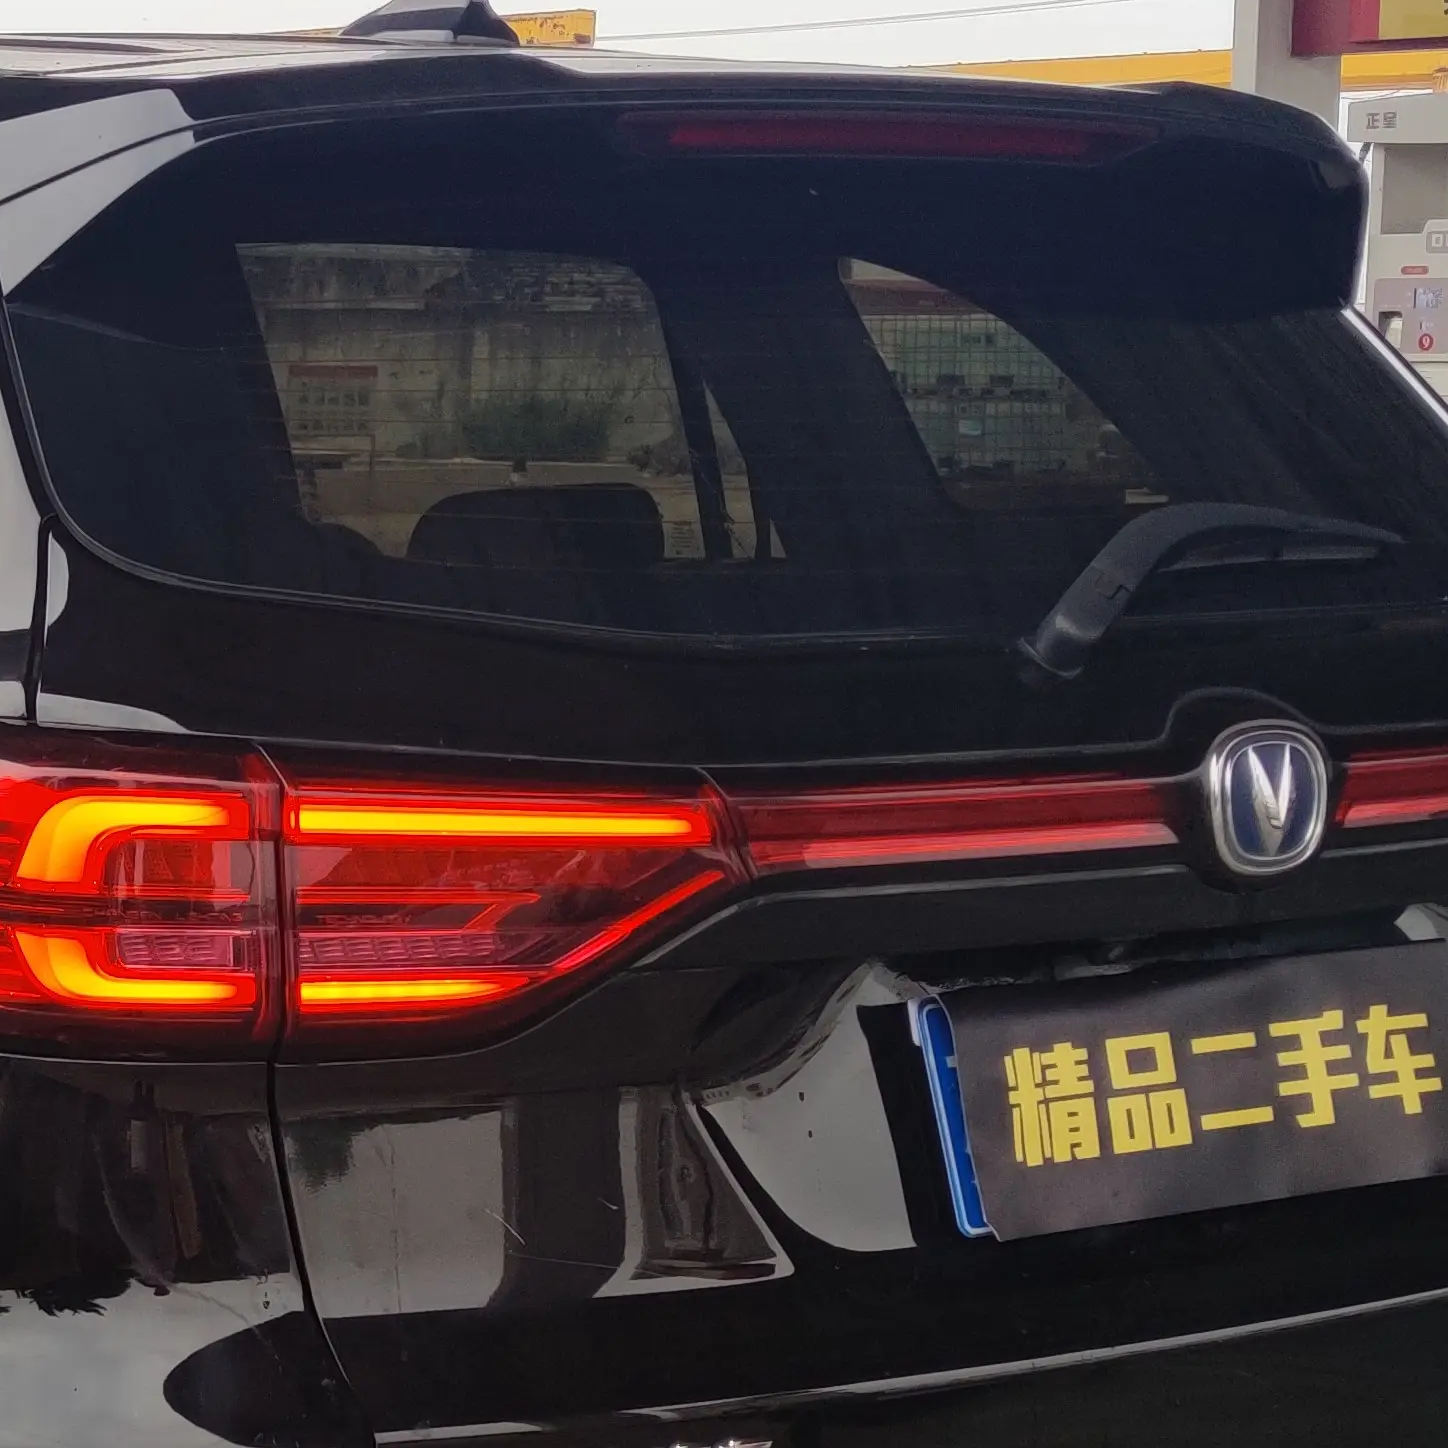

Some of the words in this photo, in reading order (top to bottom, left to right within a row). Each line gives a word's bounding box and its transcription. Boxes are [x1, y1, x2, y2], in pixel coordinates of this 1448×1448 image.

[1422, 335, 1430, 349] 9
[1004, 1004, 1443, 1167] 精品二手车
